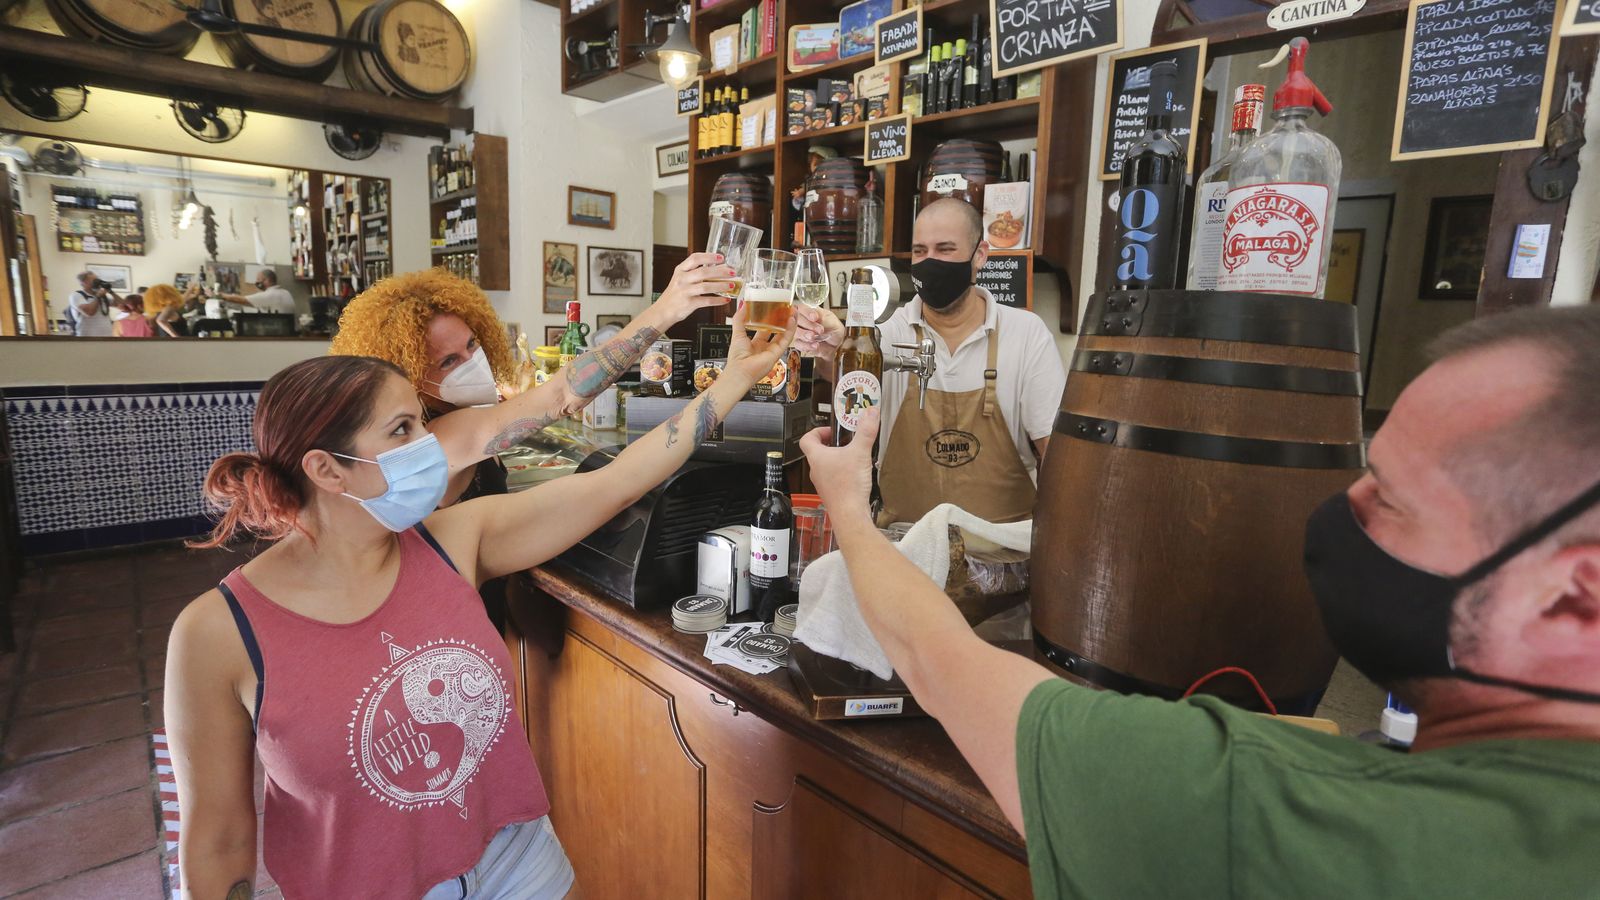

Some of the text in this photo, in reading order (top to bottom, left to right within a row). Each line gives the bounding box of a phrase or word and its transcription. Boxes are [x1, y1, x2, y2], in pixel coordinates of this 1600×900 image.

[1281, 0, 1347, 22] CANTINA
[1418, 1, 1465, 19] TABLA
[880, 20, 918, 43] FABADA
[1417, 17, 1473, 36] PICADA
[1001, 16, 1096, 62] CRIANZA
[1453, 44, 1484, 54] POLLO
[1413, 59, 1455, 72] QUESO
[1412, 73, 1459, 89] PAPAS
[1410, 84, 1498, 105] ZANAHORIAS
[882, 125, 906, 139] VINO
[667, 150, 689, 168] COLMAD
[871, 146, 904, 160] LLEVAR
[1235, 239, 1291, 251] MALAGA
[840, 376, 878, 393] VICTORIA
[841, 413, 858, 426] MÁL
[936, 442, 970, 454] COLMADO
[745, 639, 784, 653] COLMADO
[374, 718, 417, 757] LITTLE
[385, 732, 431, 775] WILD
[426, 767, 453, 791] SUMMER
